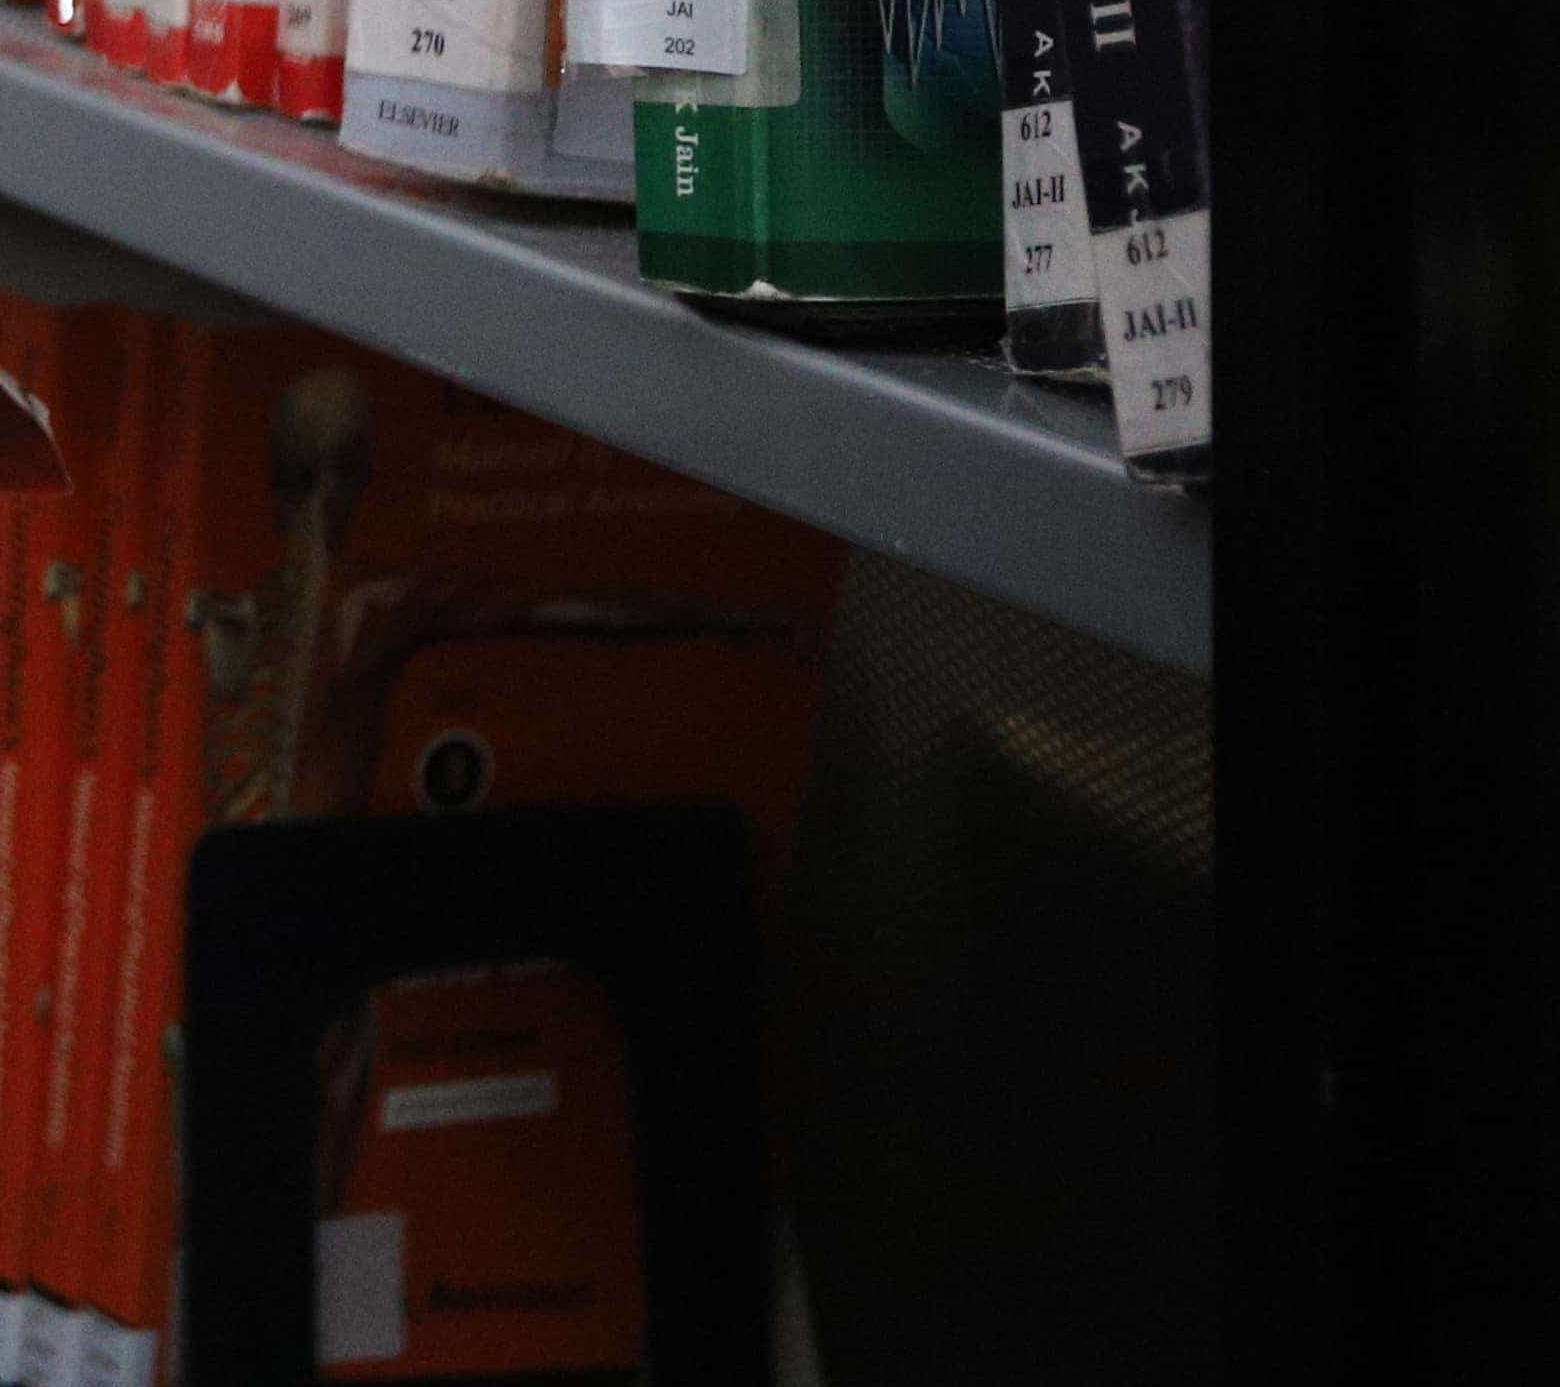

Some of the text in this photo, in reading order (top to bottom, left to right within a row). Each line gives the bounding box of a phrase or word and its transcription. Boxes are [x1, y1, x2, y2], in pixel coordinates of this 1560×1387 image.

[666, 1, 694, 19] JAI
[411, 29, 445, 57] 270
[664, 37, 696, 56] 202
[1034, 29, 1054, 59] A
[377, 99, 460, 137] ELSEVIER
[1021, 112, 1052, 140] 612
[675, 126, 699, 196] Jain
[1117, 119, 1151, 198] A K
[1012, 175, 1065, 210] JAI-II
[1024, 246, 1053, 274] 277
[1127, 233, 1168, 267] 612
[1123, 298, 1198, 342] JAI-II
[1152, 376, 1193, 411] 279
